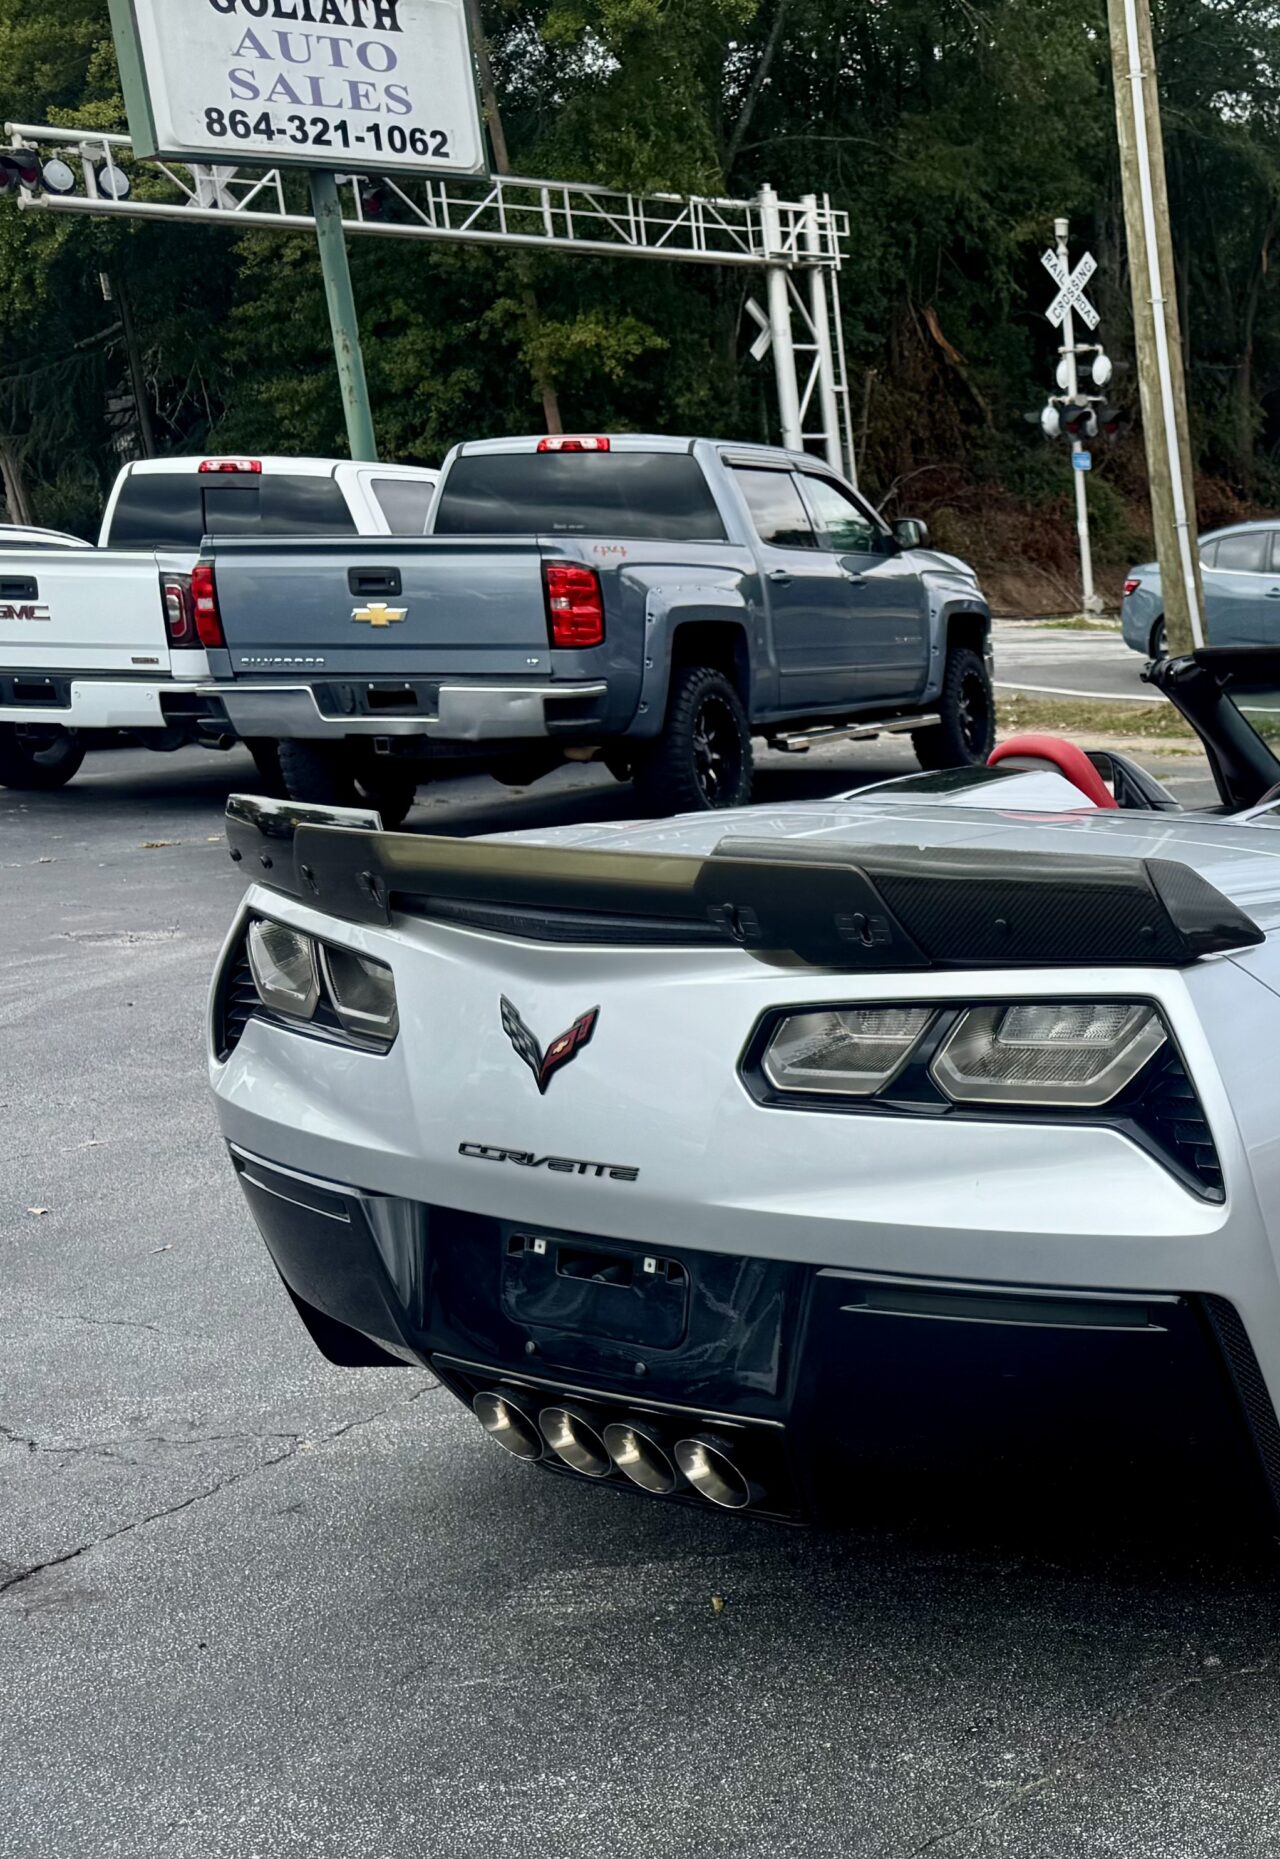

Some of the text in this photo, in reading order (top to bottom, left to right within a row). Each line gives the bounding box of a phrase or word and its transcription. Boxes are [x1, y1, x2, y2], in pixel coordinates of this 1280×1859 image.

[231, 27, 398, 72] AUTO
[228, 68, 413, 115] SALES
[204, 107, 451, 158] 864-321-1062
[1045, 253, 1066, 285] RAIL
[1053, 261, 1092, 319] CROSSING
[458, 1141, 640, 1181] CORVETTE
